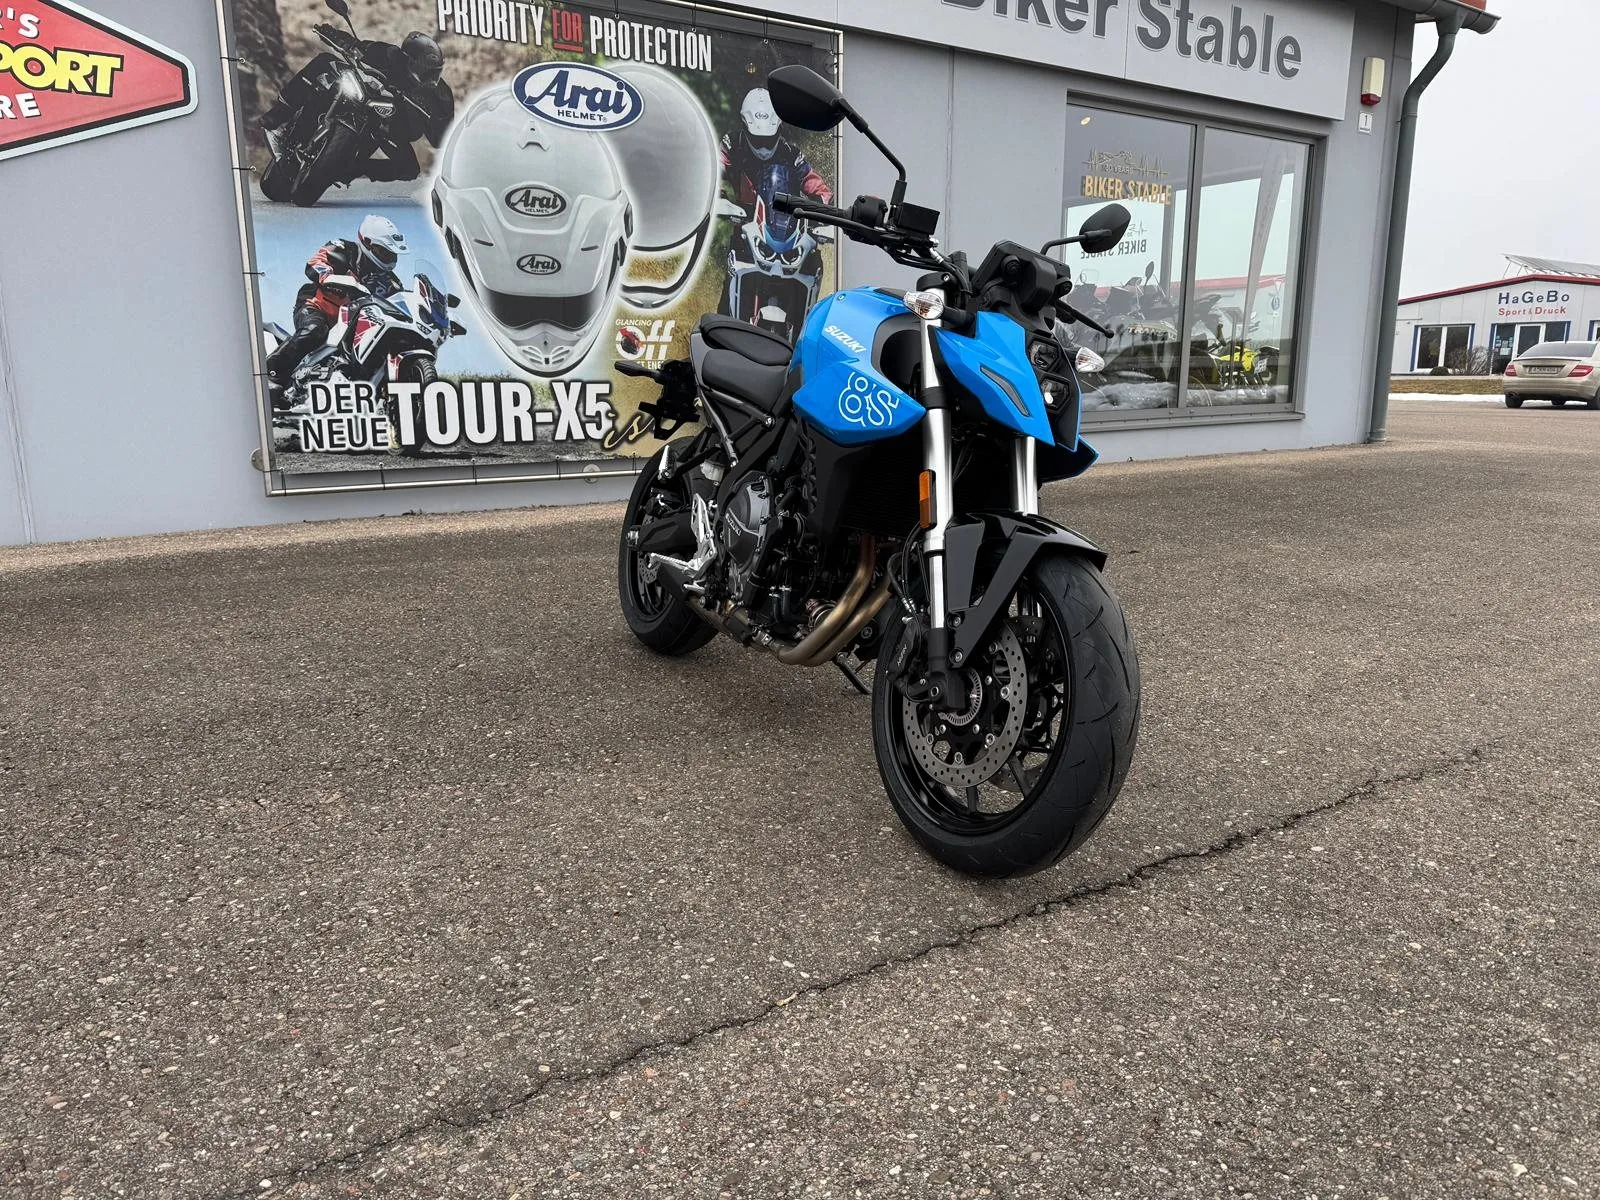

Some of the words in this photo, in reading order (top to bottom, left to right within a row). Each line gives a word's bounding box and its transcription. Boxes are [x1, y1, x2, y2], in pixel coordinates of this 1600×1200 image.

[0, 7, 40, 38] 'S
[438, 0, 543, 46] PRIORITY
[552, 9, 583, 43] FOR
[590, 16, 712, 72] PROTECTION
[1136, 0, 1302, 80] Stable
[524, 70, 628, 114] Arai
[557, 110, 603, 121] HELMET
[511, 190, 560, 210] Arai
[1084, 176, 1123, 200] BIKER
[1127, 180, 1172, 206] STABLE
[521, 256, 557, 270] Arai
[1498, 290, 1570, 305] HaGeBo
[1498, 308, 1526, 316] Sport
[1535, 306, 1566, 315] Druck
[825, 325, 867, 353] SUZUKI
[310, 384, 374, 415] DER
[387, 381, 614, 446] TOUR-X5
[302, 417, 388, 450] NEUE
[604, 412, 655, 448] is
